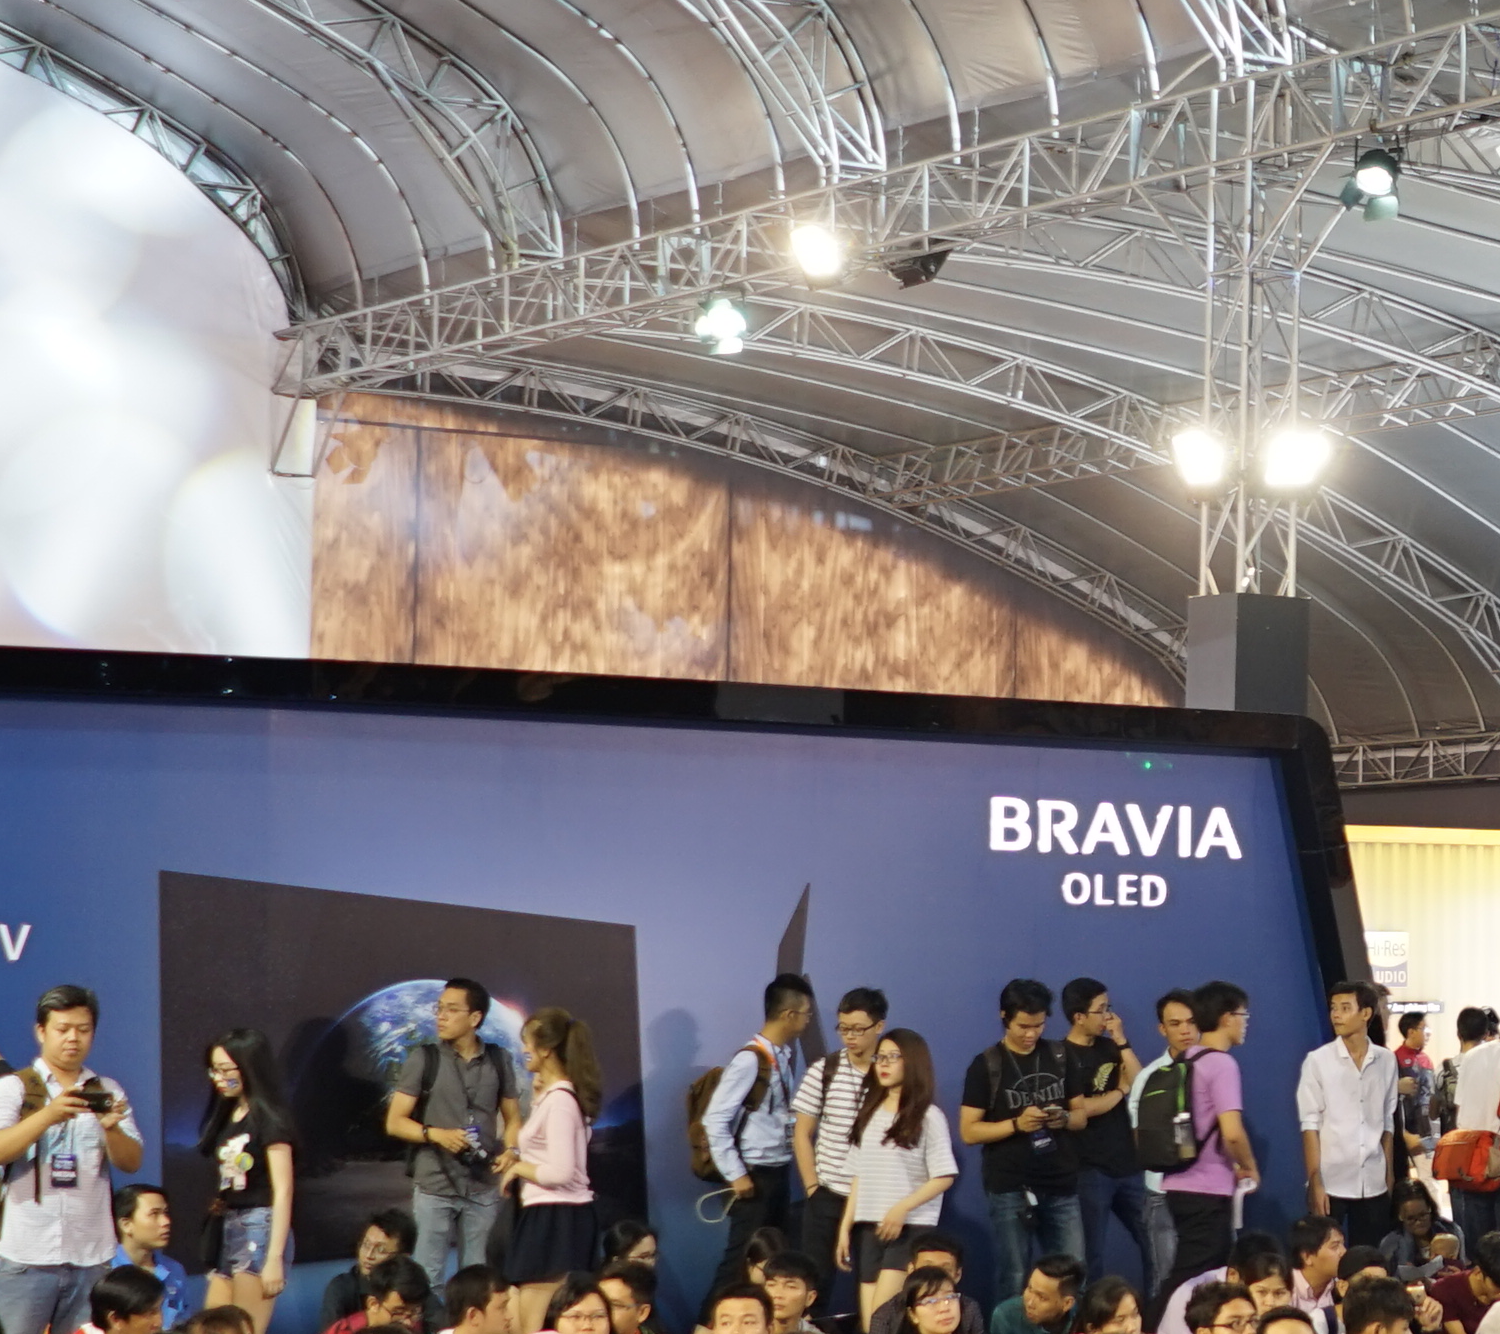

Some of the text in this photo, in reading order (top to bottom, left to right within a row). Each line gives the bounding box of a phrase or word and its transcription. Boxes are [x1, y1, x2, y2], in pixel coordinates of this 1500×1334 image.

[989, 795, 1243, 860] BRAVIA
[1060, 871, 1168, 908] OLED
[1375, 970, 1407, 984] UDIO
[1004, 1077, 1066, 1110] DENIM
